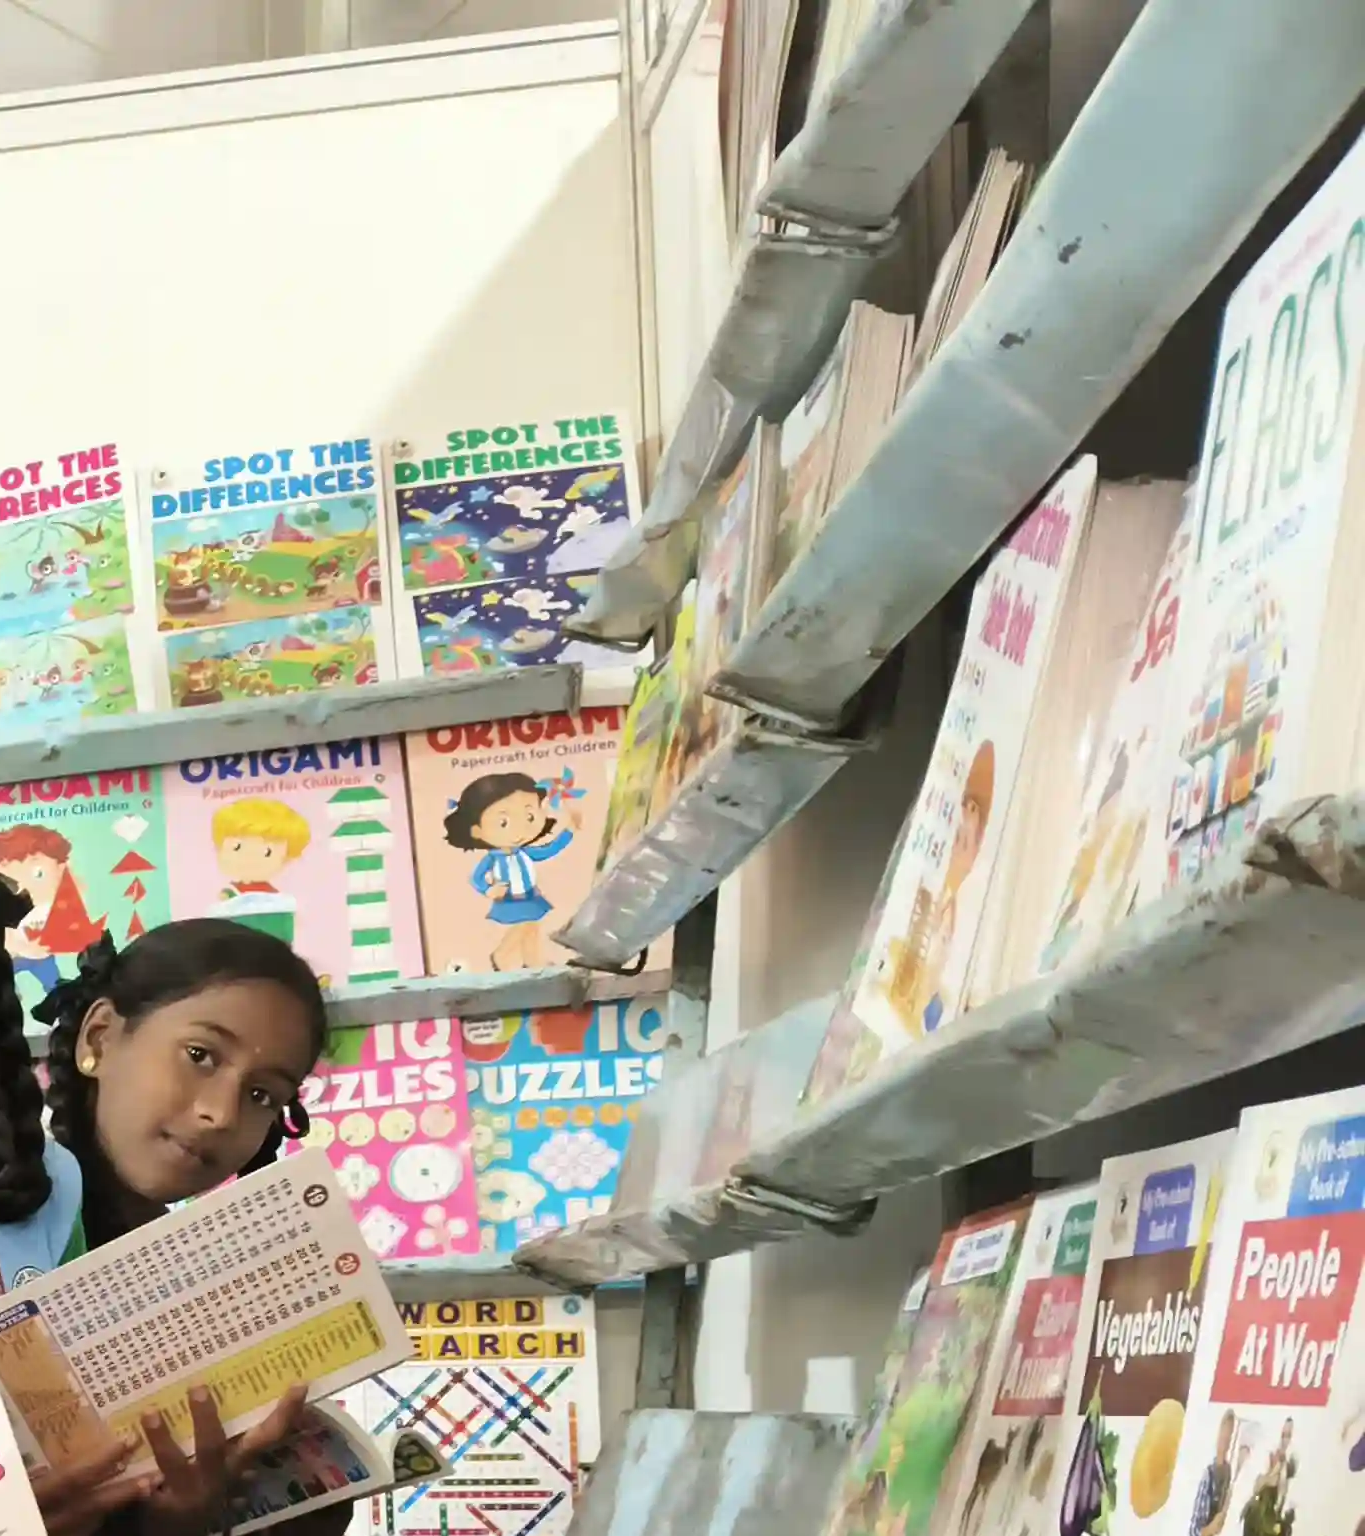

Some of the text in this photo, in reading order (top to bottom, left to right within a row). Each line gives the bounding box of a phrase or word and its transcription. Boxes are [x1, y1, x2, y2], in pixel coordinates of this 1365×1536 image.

[446, 415, 619, 453] SPOT THE
[57, 442, 119, 478] THE
[203, 437, 373, 483] SPOT THE
[393, 437, 623, 486] DIFFERENCES
[151, 466, 376, 520] DIFFERENCES
[178, 736, 382, 783] ORIGAMI
[450, 740, 617, 769] Papercraft for Children
[302, 771, 364, 791] Children
[49, 800, 130, 819] for Children
[373, 1017, 453, 1062] IQ
[598, 998, 669, 1054] IQ
[1237, 1229, 1342, 1313] People
[400, 1300, 538, 1325] WORD
[1095, 1291, 1203, 1375] Vegetables
[1235, 1322, 1266, 1375] At
